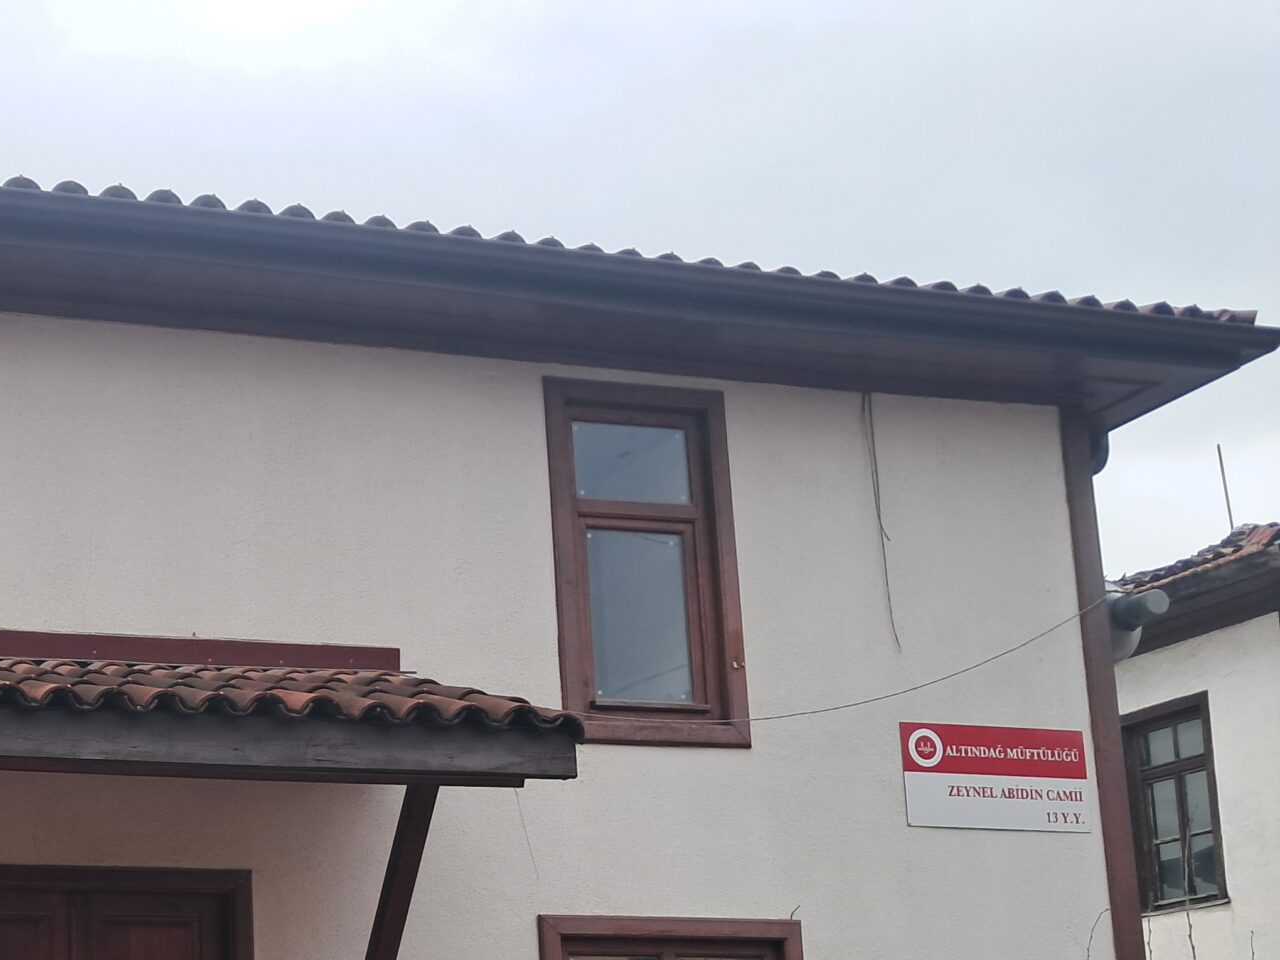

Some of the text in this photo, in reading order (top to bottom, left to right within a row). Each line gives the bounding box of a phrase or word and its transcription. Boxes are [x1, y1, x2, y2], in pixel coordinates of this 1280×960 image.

[945, 744, 1080, 762] ALTINDAĞ MÜFTÜLÜĞÜ
[948, 784, 1084, 802] ZEYNEL ABİDİN CAMİİ
[1046, 811, 1086, 825] 13 Y.Y.
